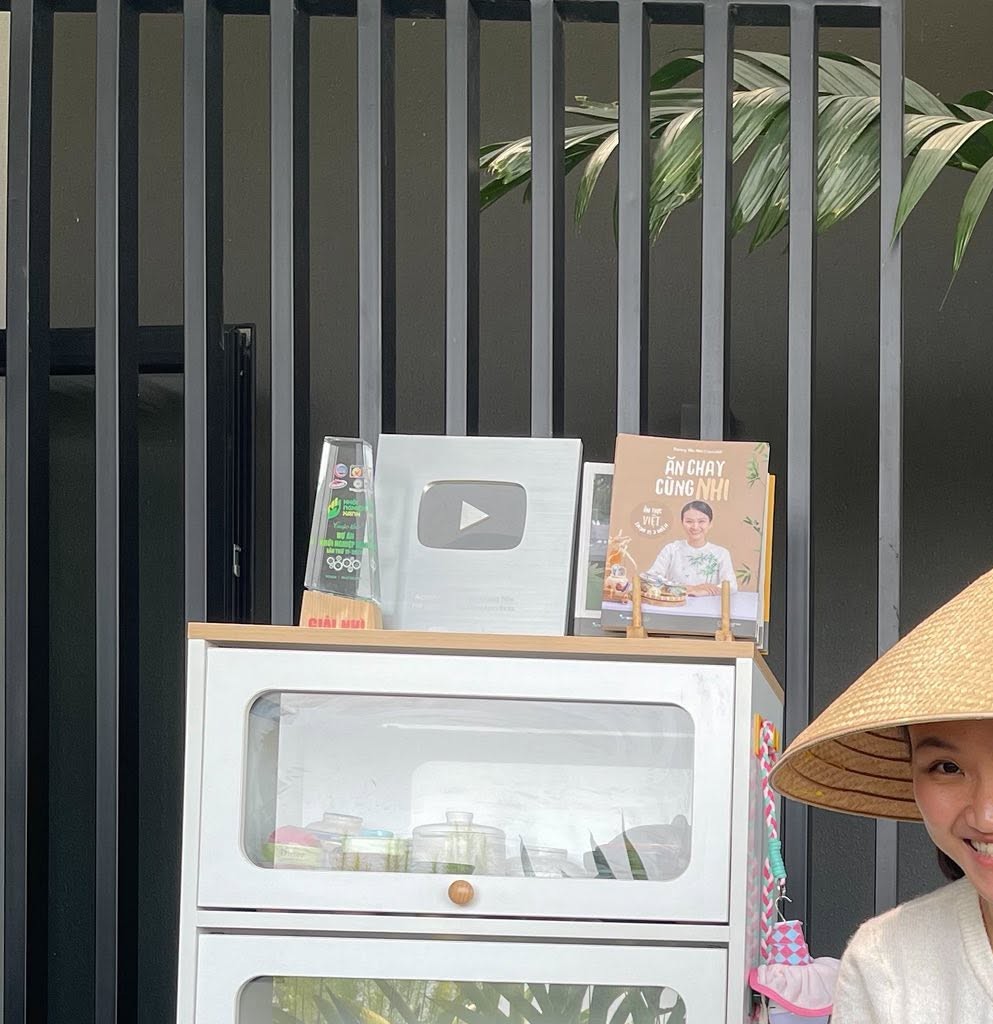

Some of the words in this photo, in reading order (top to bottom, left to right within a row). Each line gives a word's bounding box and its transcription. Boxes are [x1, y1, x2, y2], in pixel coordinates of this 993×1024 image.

[665, 456, 685, 476] ĂN
[687, 459, 726, 478] CHAY
[696, 477, 730, 501] NHI
